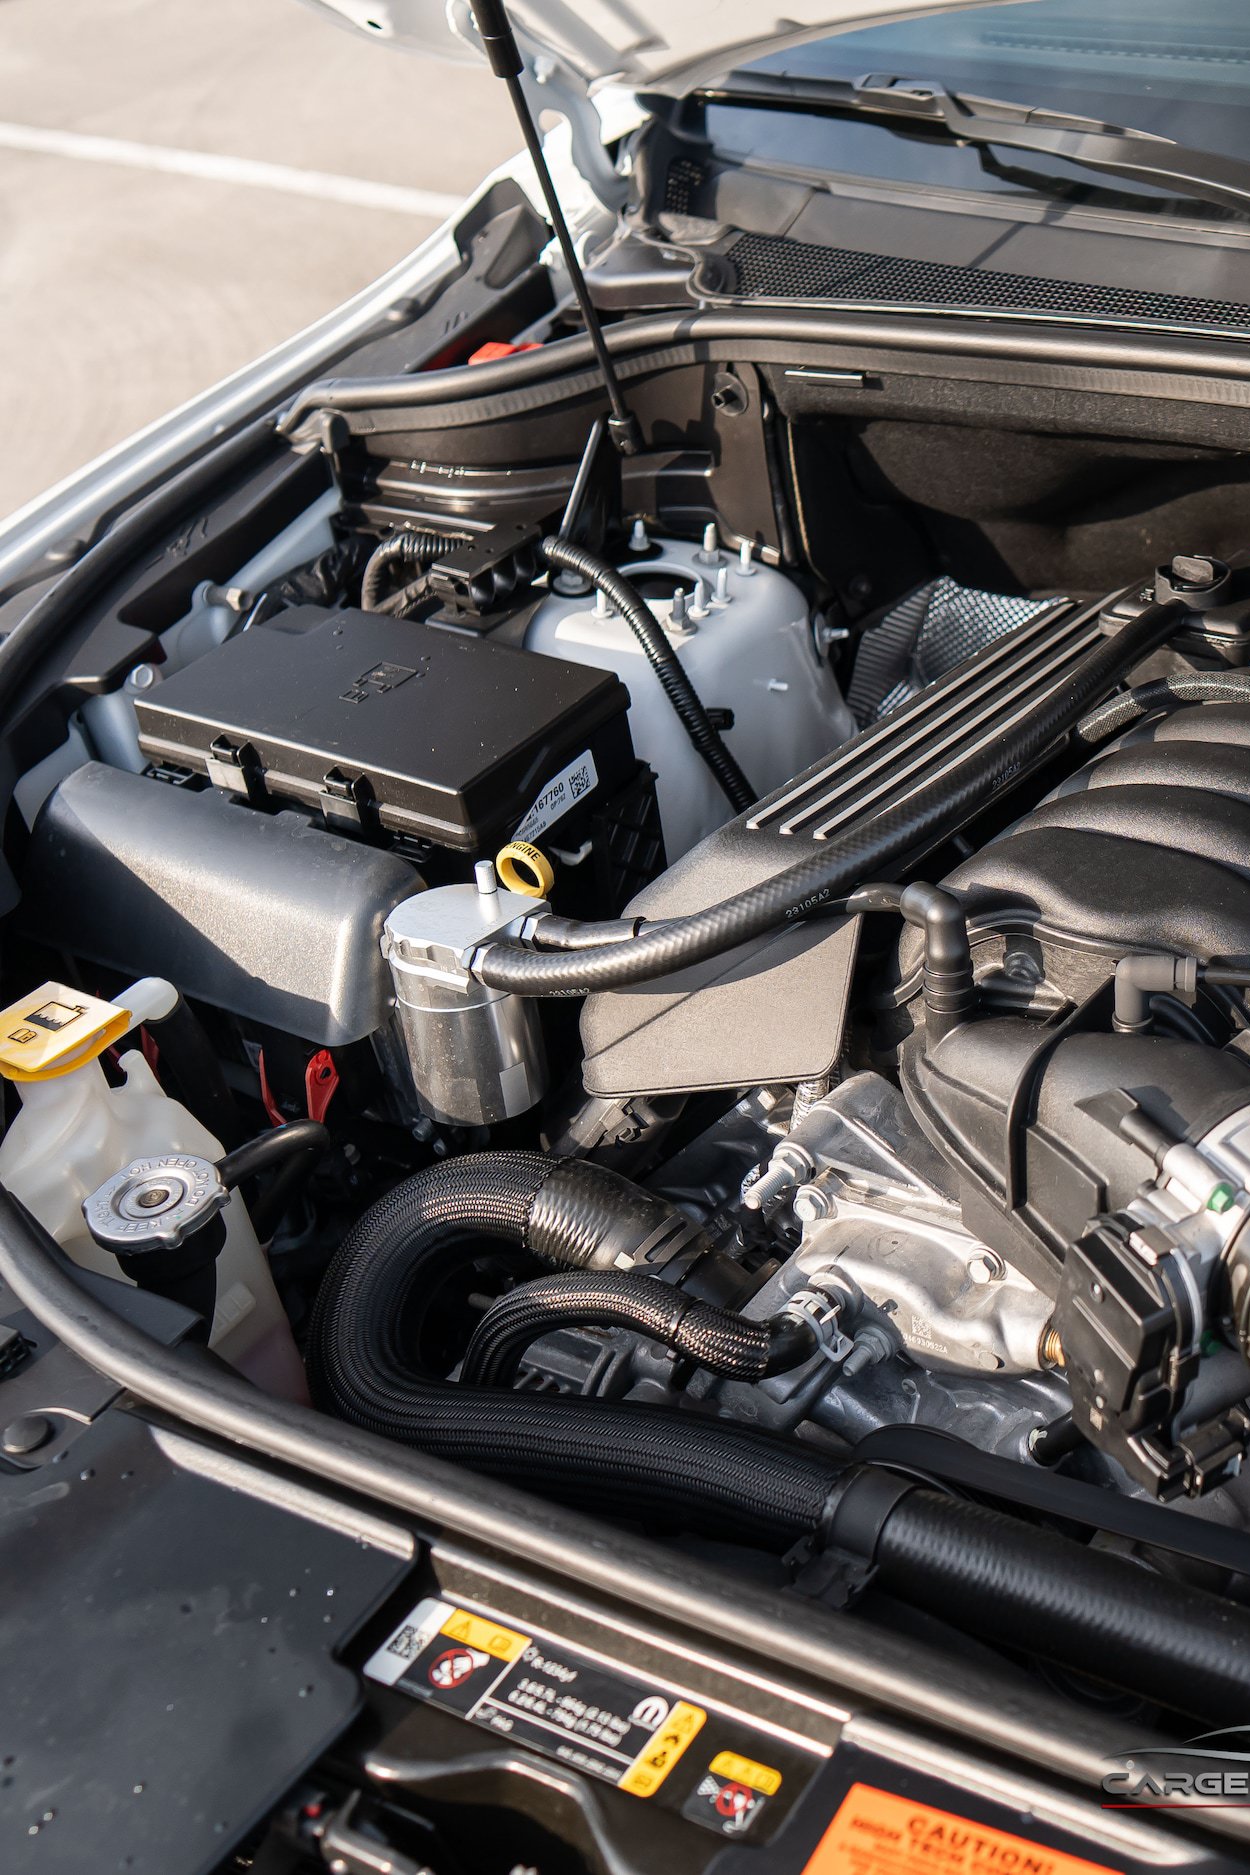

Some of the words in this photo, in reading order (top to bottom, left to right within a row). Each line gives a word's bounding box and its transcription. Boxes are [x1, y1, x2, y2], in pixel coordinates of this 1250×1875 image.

[785, 888, 830, 918] 23105A2
[156, 1157, 197, 1170] OPEN
[118, 1217, 163, 1233] KEEP
